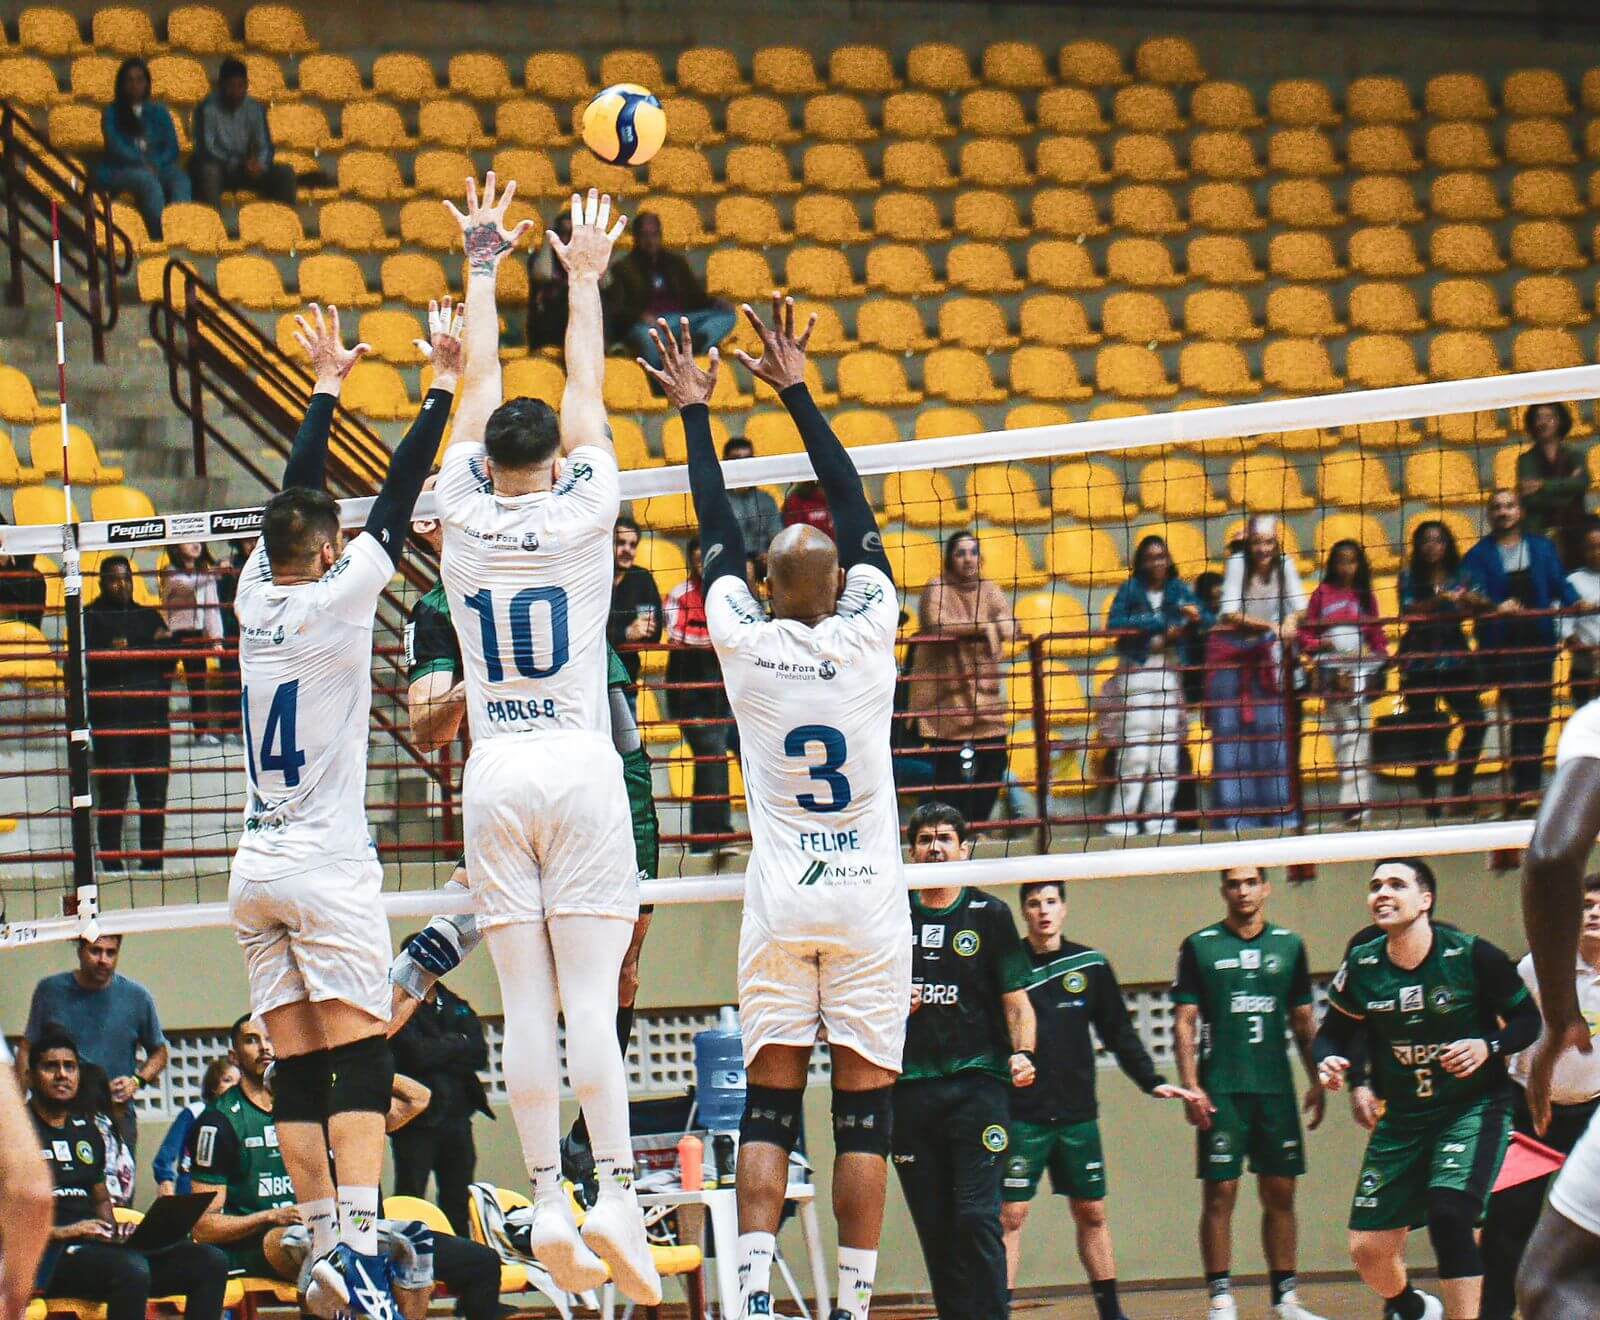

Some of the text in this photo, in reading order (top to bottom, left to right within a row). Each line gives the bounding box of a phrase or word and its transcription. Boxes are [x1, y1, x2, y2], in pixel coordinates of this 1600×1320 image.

[111, 523, 164, 540] Pequita
[496, 533, 518, 543] Fora
[464, 585, 569, 683] 10
[754, 657, 815, 673] Juiz de Fora
[775, 671, 816, 681] Prefeitura
[784, 724, 852, 814] 3
[800, 830, 861, 852] FELIPE
[922, 983, 959, 1005] BRB
[1246, 1015, 1264, 1044] 3
[1414, 1044, 1450, 1064] BR
[273, 1175, 295, 1196] BR
